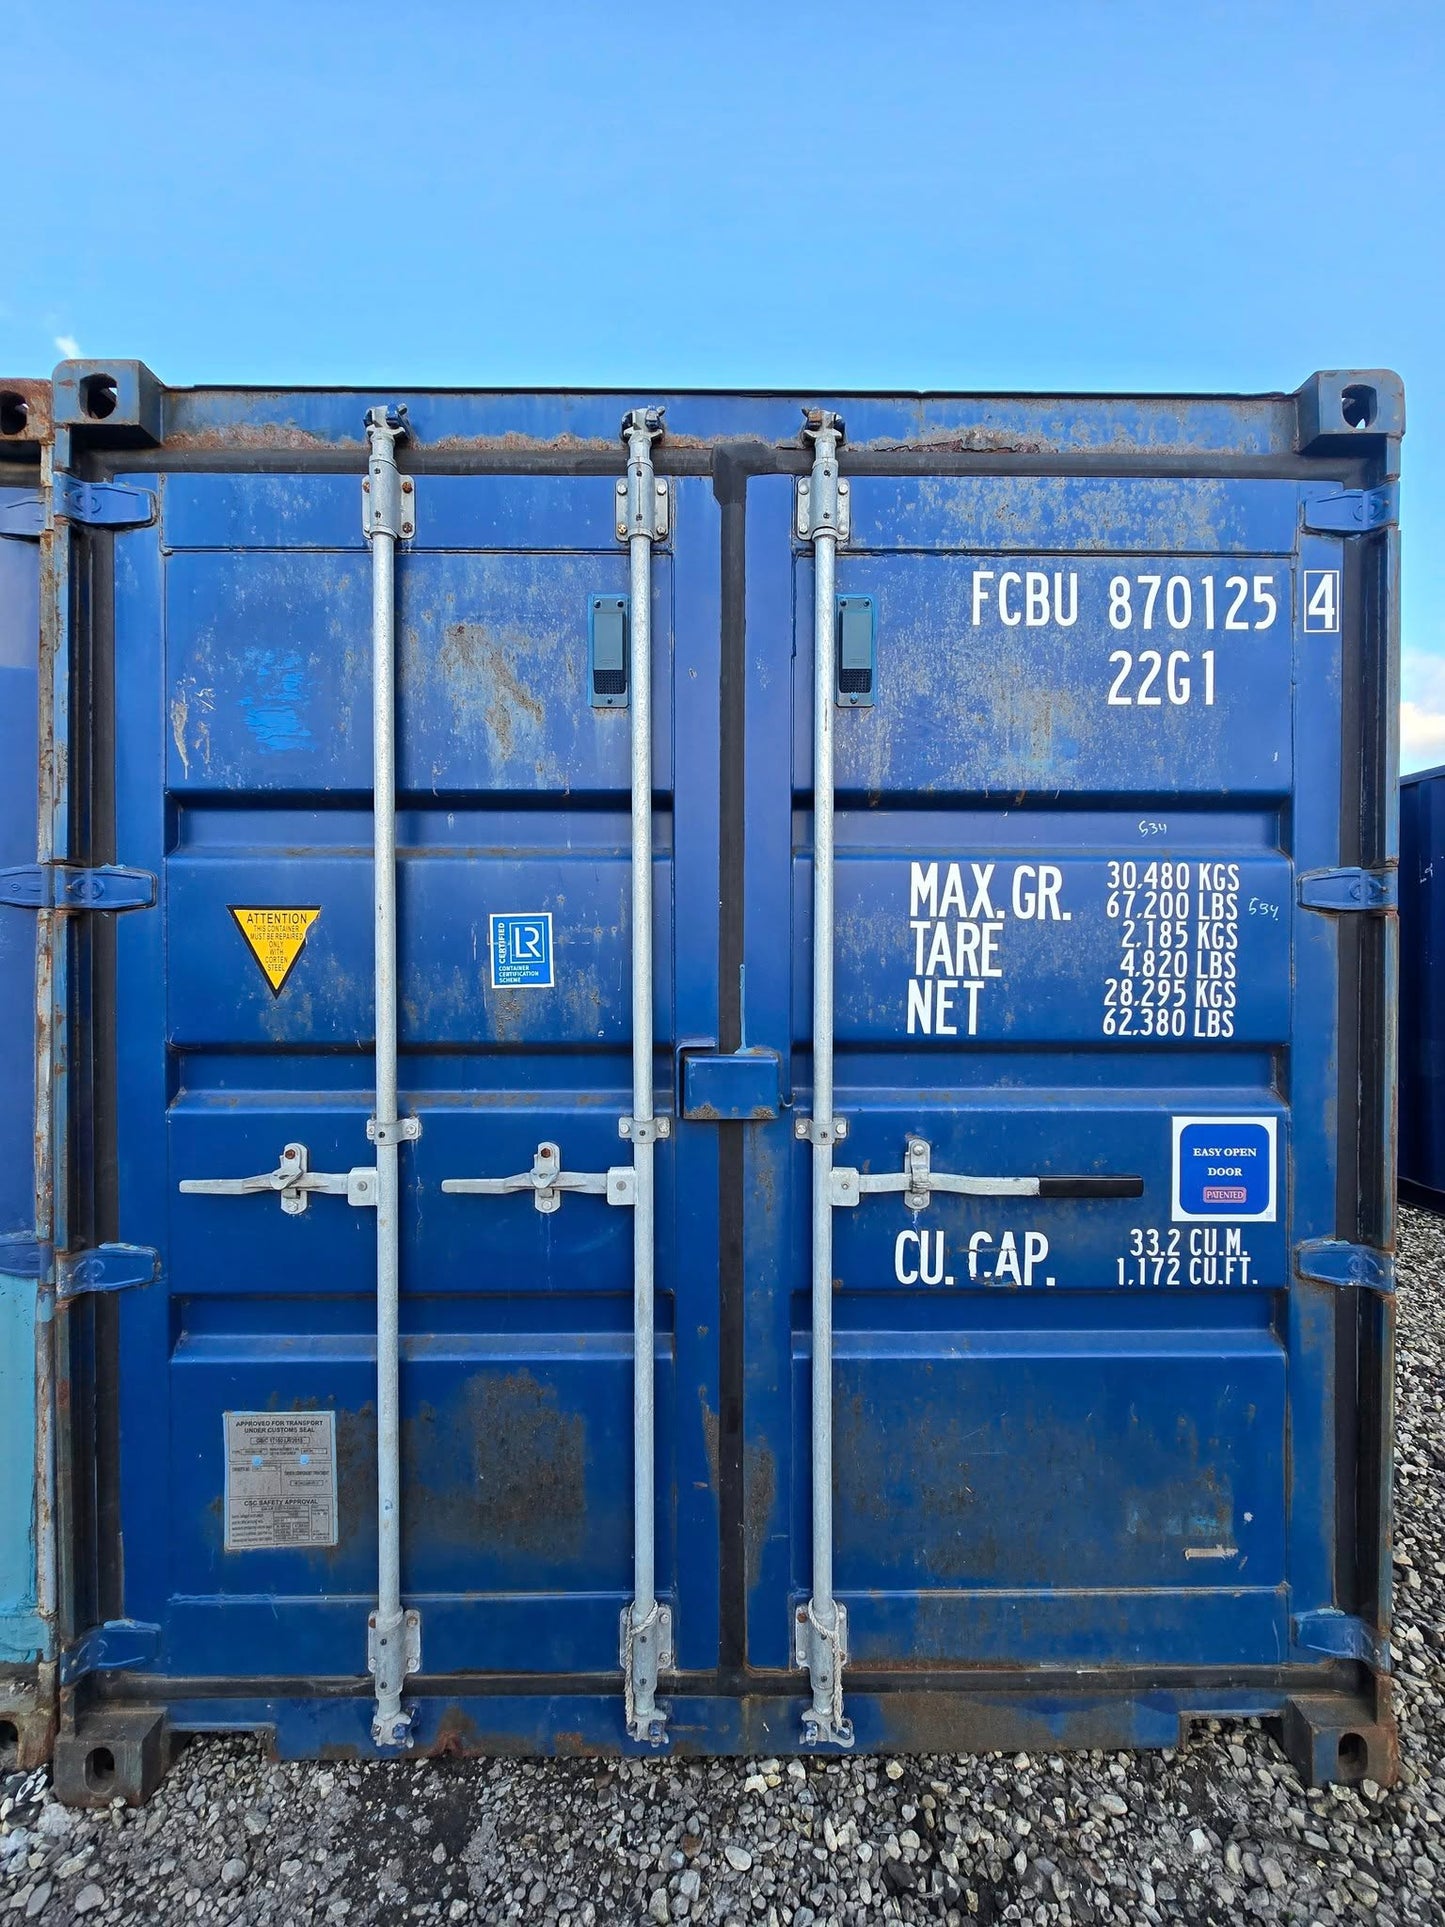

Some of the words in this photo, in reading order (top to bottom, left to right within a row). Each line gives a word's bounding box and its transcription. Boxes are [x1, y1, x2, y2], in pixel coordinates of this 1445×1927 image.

[972, 570, 1078, 627] FCBU
[1108, 575, 1277, 630] 870125
[1308, 574, 1336, 629] 4
[1107, 650, 1214, 705] 22G1
[910, 861, 1005, 919] MAX.
[1012, 865, 1072, 921] GR.
[1107, 861, 1190, 890] 30,480
[1199, 863, 1240, 892] KGS
[246, 913, 307, 925] ATTENTION
[1106, 890, 1189, 920] 67,200
[1198, 892, 1238, 921] LBS
[268, 940, 283, 948] ONLY
[498, 922, 506, 964] CERTIFIED
[515, 926, 541, 958] LR
[909, 920, 1004, 977] TARE
[1121, 920, 1188, 949] 2,185
[1197, 921, 1238, 950] KGS
[267, 964, 285, 972] STEEL
[499, 970, 539, 978] CERTIFICATION
[1120, 949, 1188, 978] 4,820
[1196, 950, 1236, 979] LBS
[907, 979, 985, 1035] NET
[1104, 978, 1186, 1008] 28,295
[1195, 980, 1236, 1008] KGS
[1103, 1008, 1186, 1036] 62,380
[1194, 1009, 1234, 1038] LBS
[1193, 1147, 1222, 1157] EASY
[1223, 1147, 1257, 1157] OPEN
[1207, 1167, 1243, 1176] DOOR
[1206, 1190, 1244, 1199] PATENTED
[1130, 1228, 1181, 1256] 33.2
[1190, 1228, 1248, 1256] CU.M.
[895, 1230, 954, 1285] CU.
[968, 1231, 1055, 1286] CAP.
[1117, 1257, 1180, 1285] 1,172
[1189, 1257, 1258, 1285] CU.FT.
